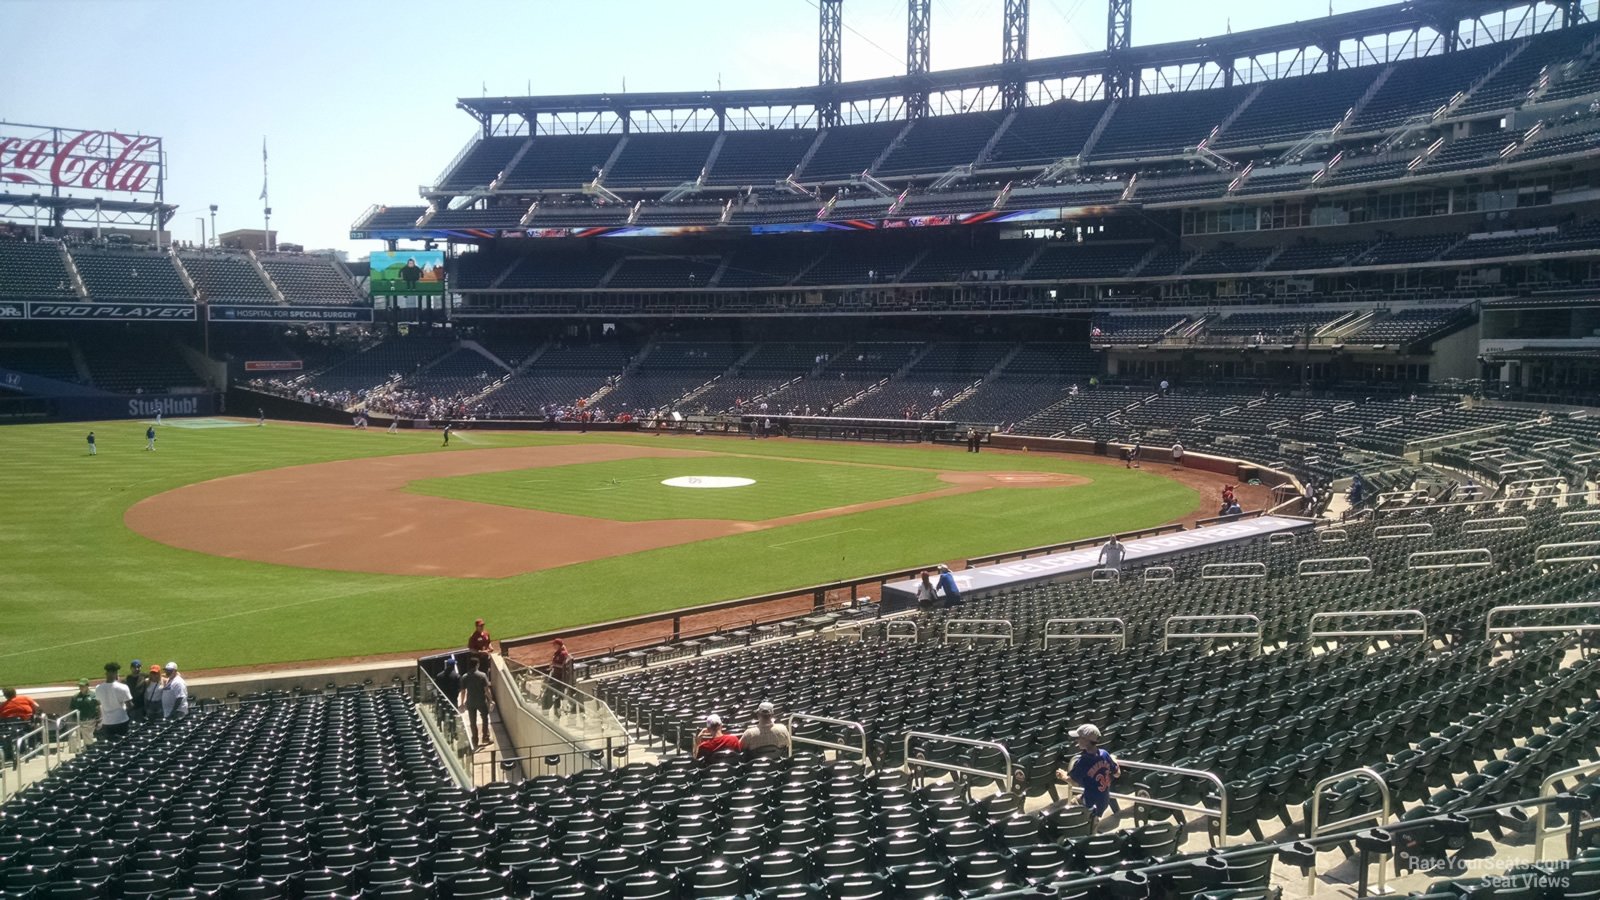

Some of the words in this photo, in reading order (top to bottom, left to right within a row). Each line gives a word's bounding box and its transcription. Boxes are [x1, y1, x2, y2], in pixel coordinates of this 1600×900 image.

[32, 306, 92, 316] PRO
[93, 307, 194, 318] PLAYER
[236, 309, 273, 318] HOSPITAL
[273, 310, 289, 318] FOR
[289, 310, 322, 318] SPECIAL
[322, 311, 357, 319] SURGERY
[128, 397, 198, 416] StubHub!
[980, 550, 1106, 578] WELCOM
